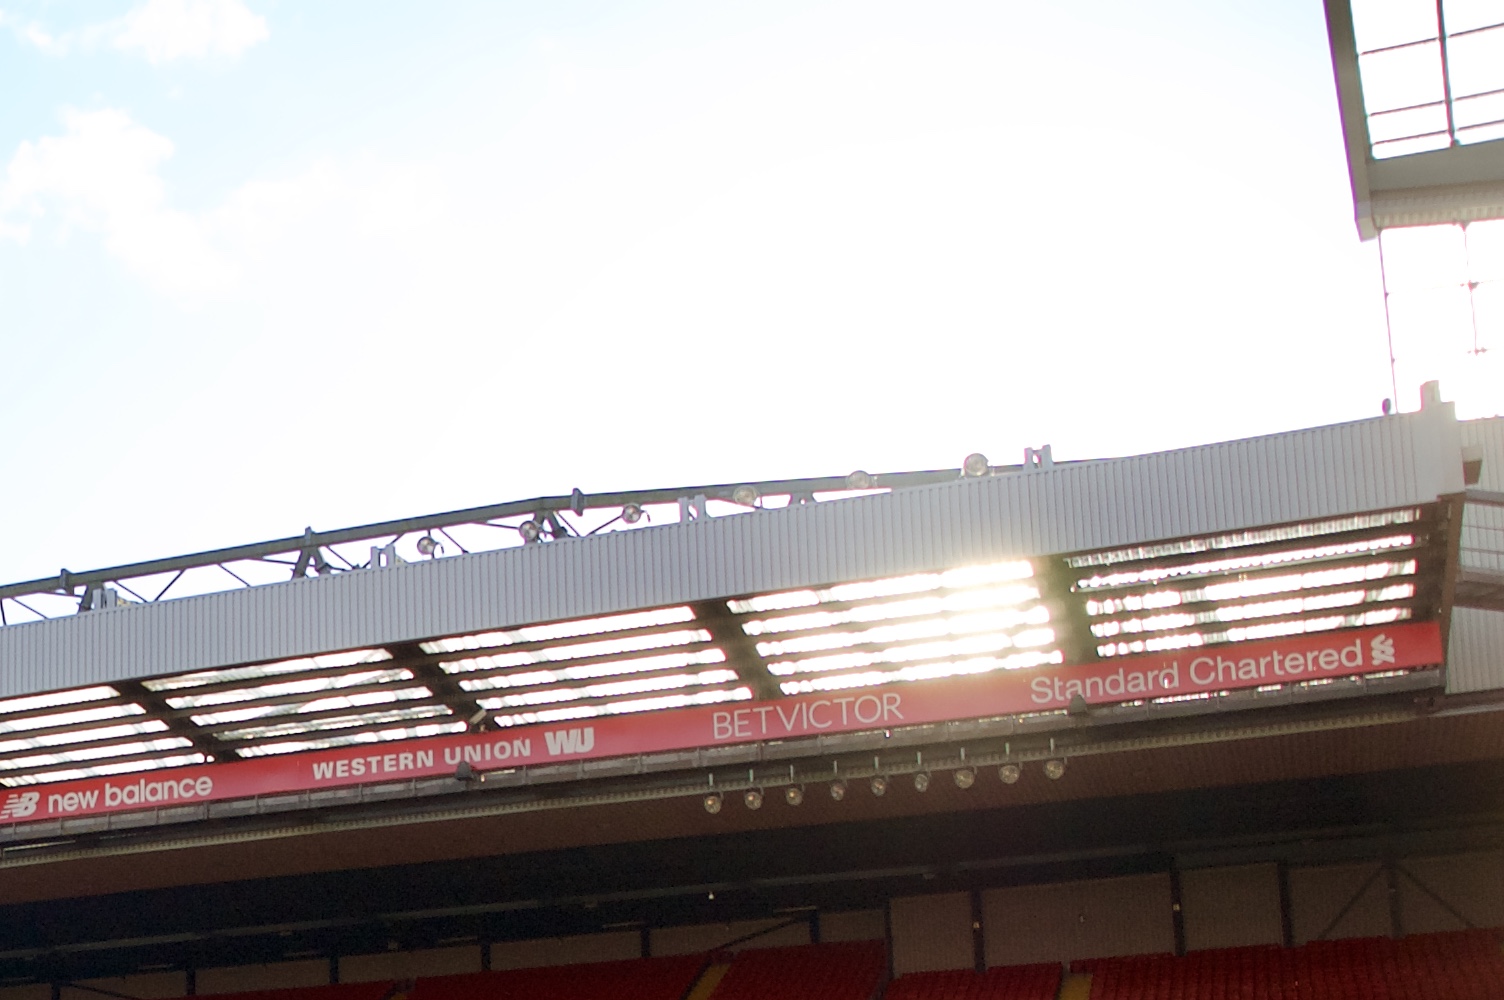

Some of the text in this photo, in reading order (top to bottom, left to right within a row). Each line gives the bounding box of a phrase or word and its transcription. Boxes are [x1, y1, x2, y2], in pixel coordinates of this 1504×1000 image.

[1030, 639, 1363, 705] Standard Chartered
[713, 693, 905, 740] BETVICTOR
[312, 750, 434, 780] WESTERN
[444, 739, 531, 766] UNION
[48, 789, 99, 813] new
[105, 776, 213, 807] balance
